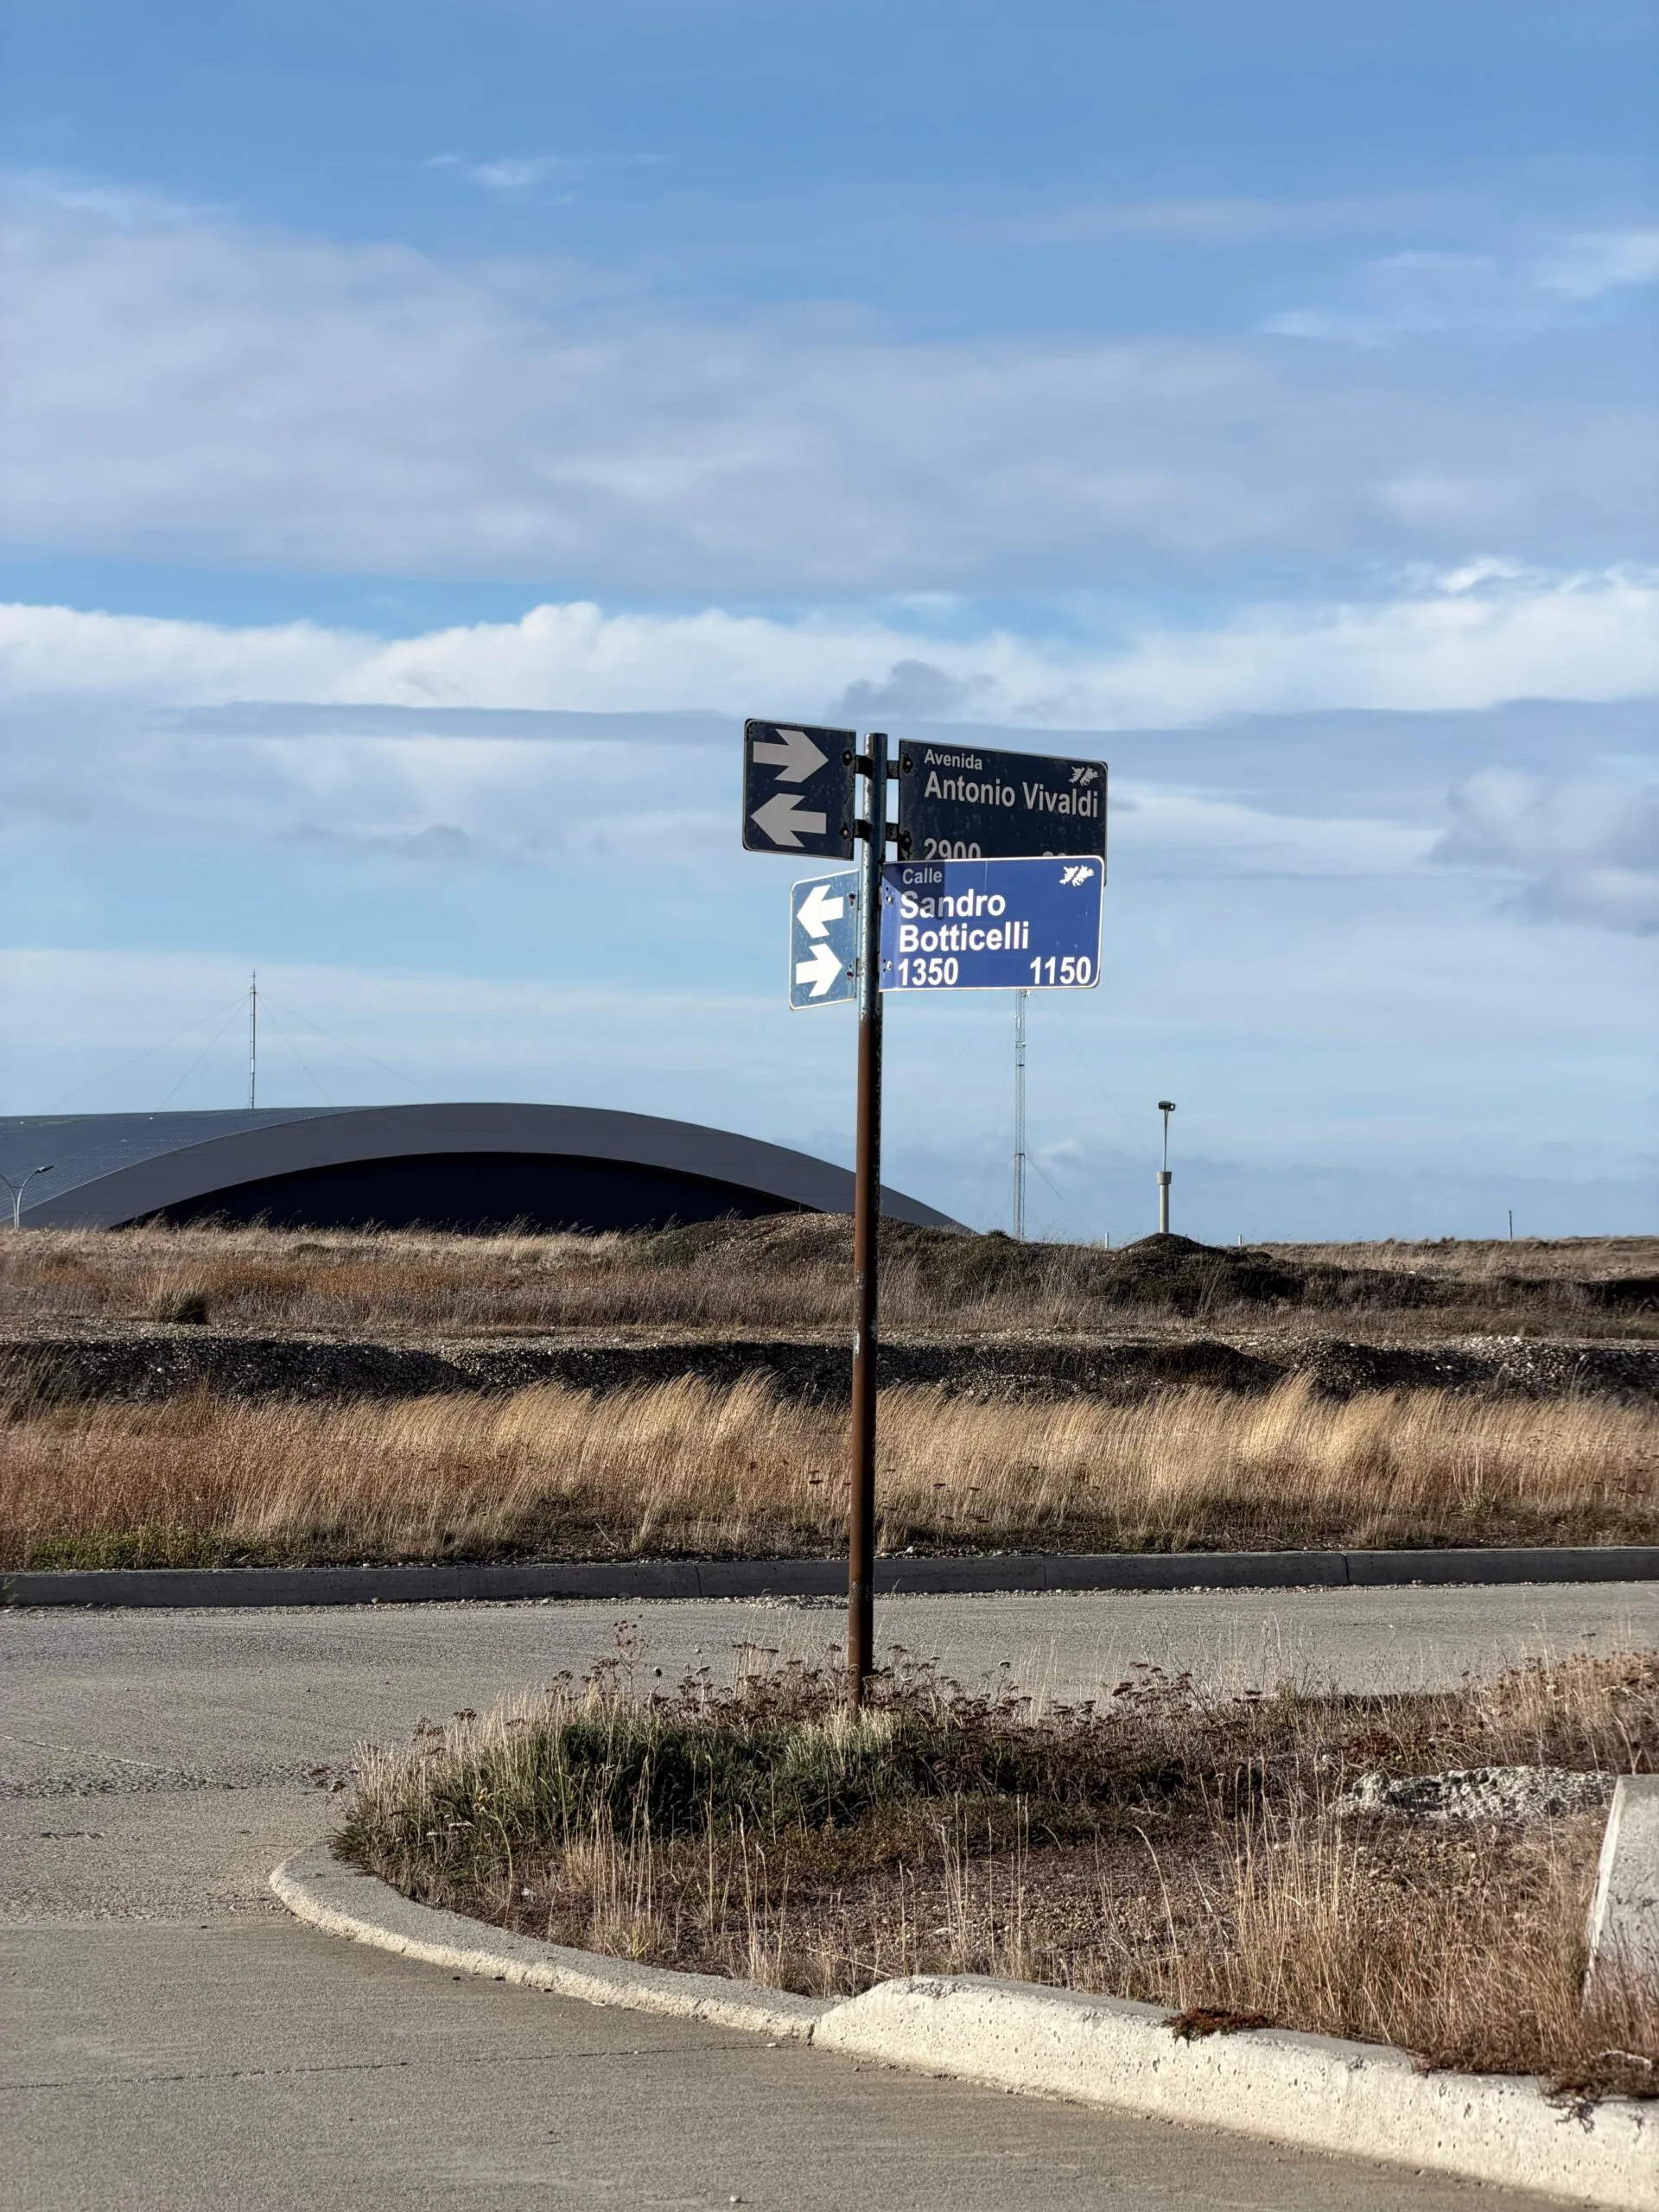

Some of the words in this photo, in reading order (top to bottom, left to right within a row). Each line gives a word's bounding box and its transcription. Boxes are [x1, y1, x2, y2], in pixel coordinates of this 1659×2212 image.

[924, 748, 982, 771] Avenida
[924, 771, 1016, 808] Antonio
[1022, 781, 1098, 818] Vivaldi
[902, 868, 943, 885] Calle
[899, 888, 1007, 919] Sandro
[899, 920, 1029, 953] Botticelli
[898, 957, 959, 986] 1350
[1030, 956, 1091, 985] 1150
